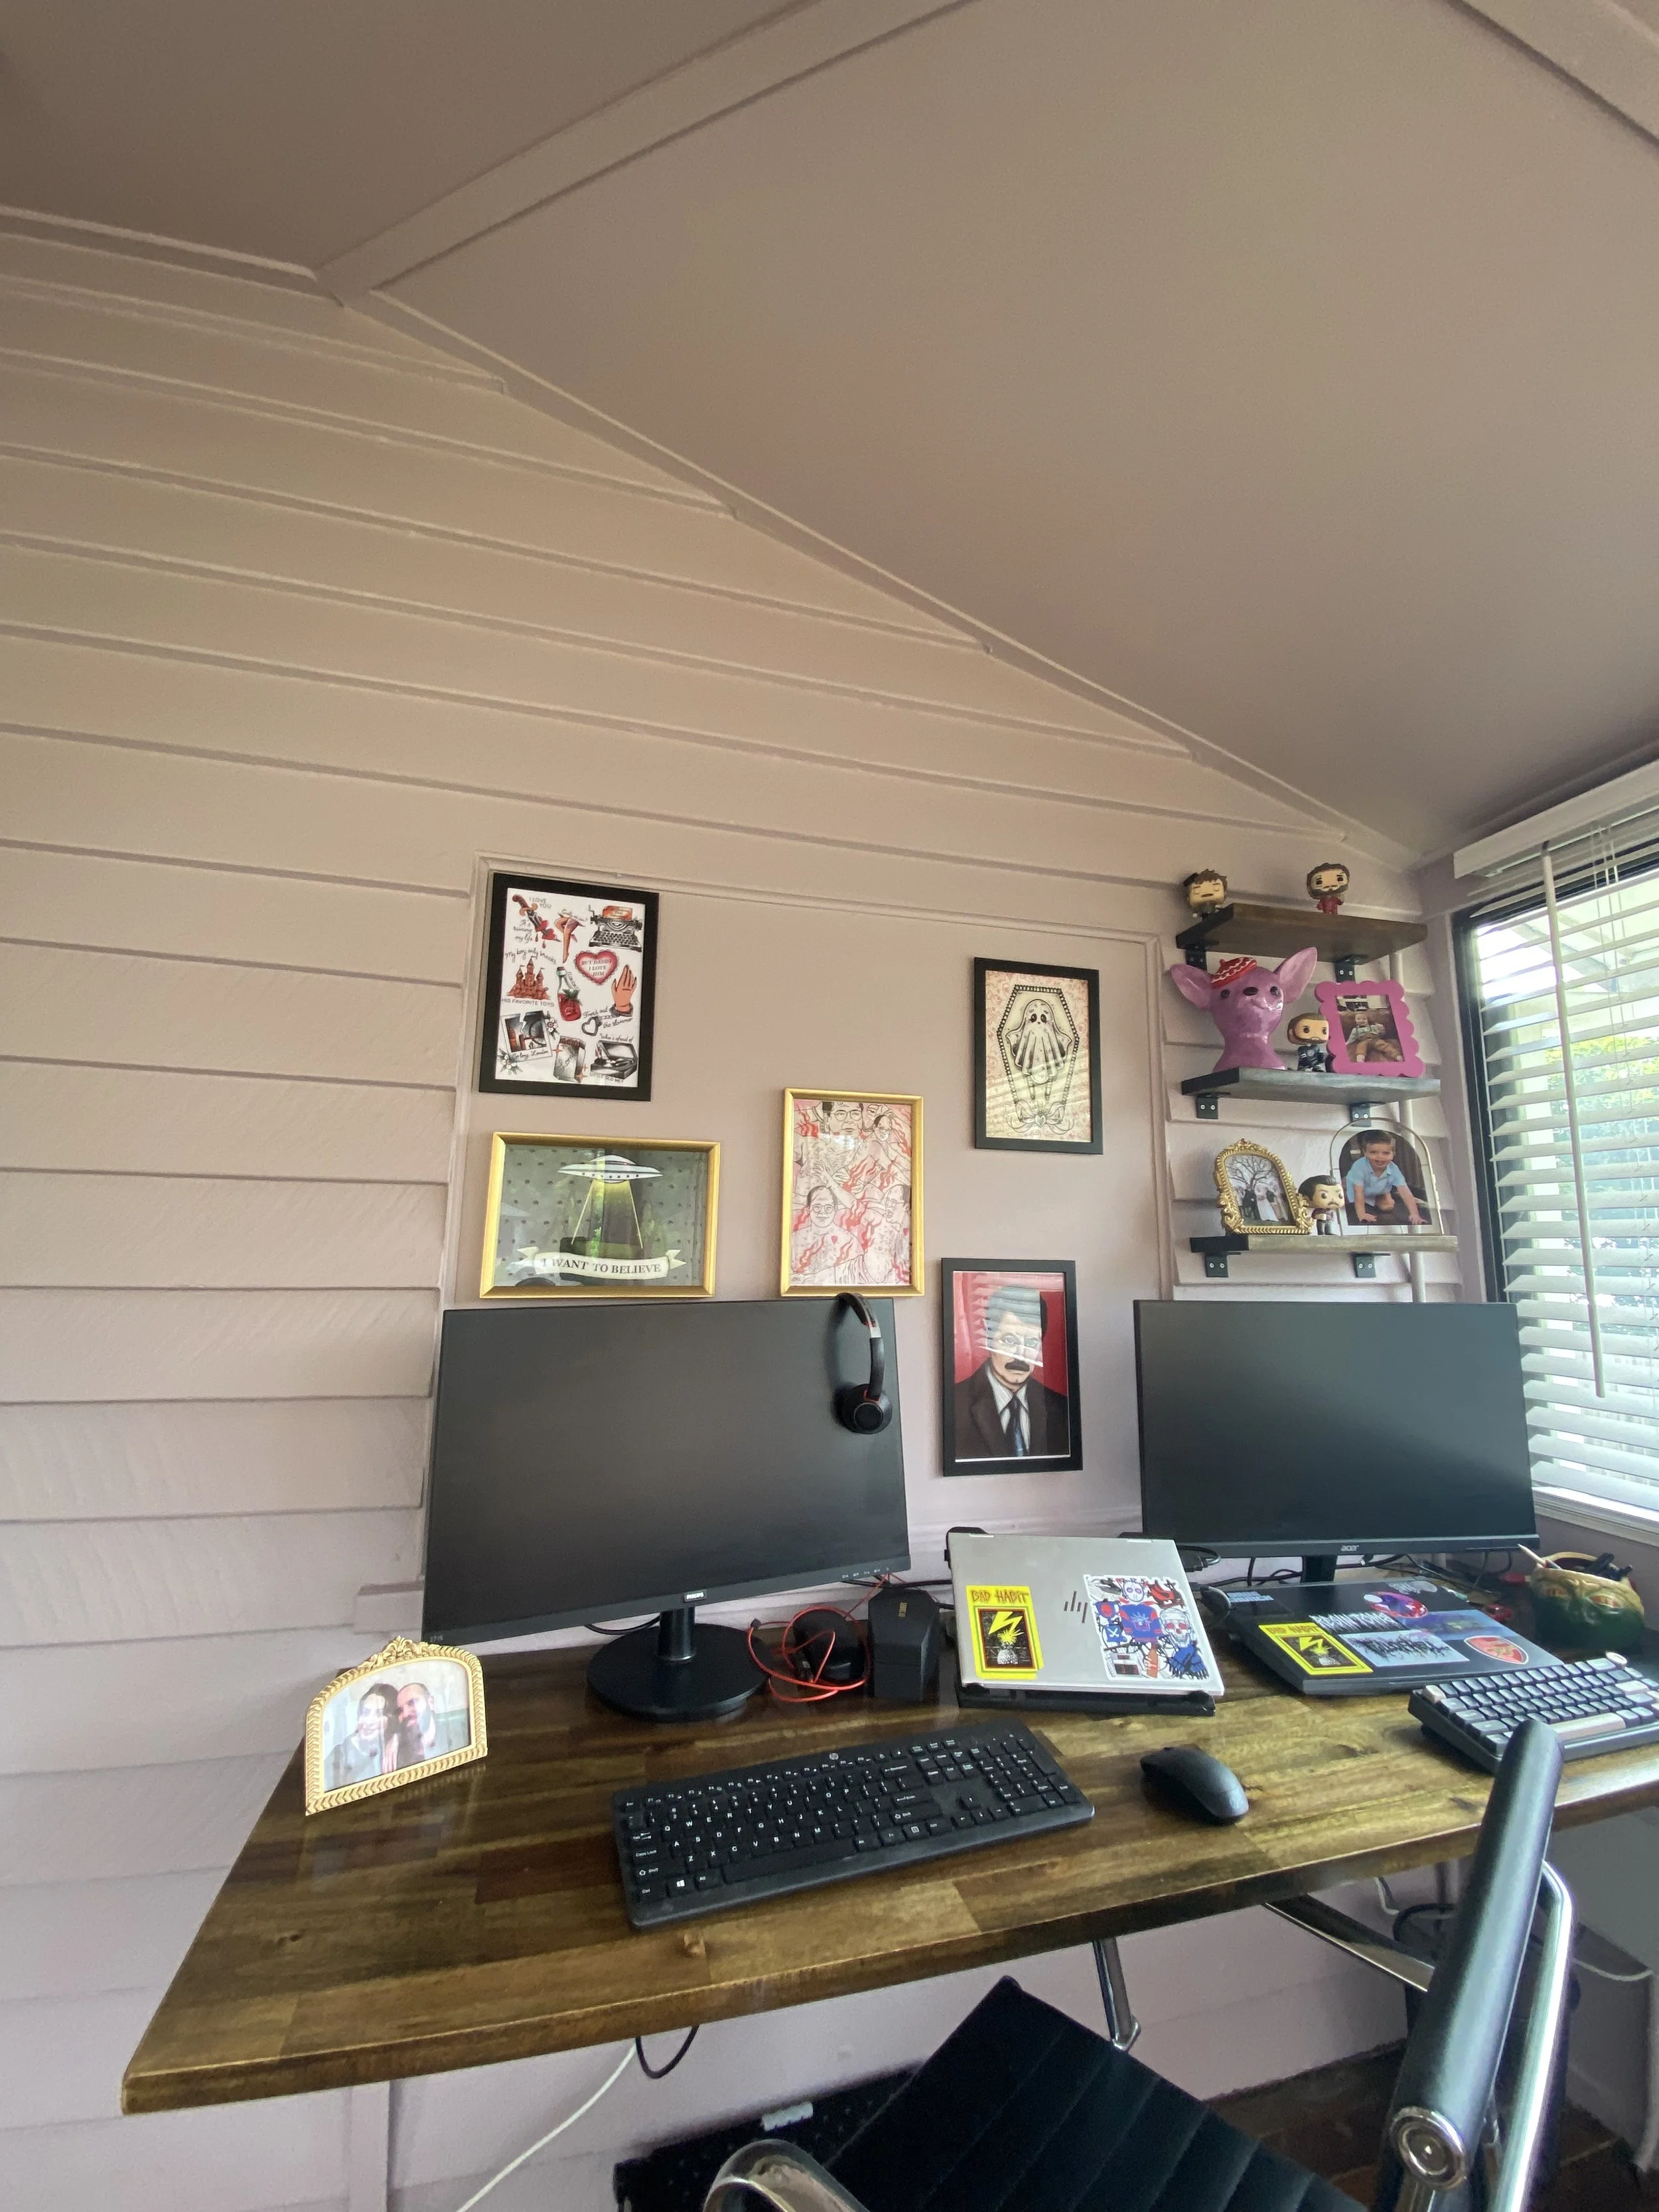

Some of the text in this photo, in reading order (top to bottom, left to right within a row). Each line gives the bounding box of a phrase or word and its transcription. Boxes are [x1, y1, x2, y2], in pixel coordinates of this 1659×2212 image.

[552, 1258, 589, 1270] WANT
[593, 1264, 609, 1272] TO
[611, 1264, 661, 1274] BELIEVE
[971, 1589, 1029, 1603] BAD HABIT
